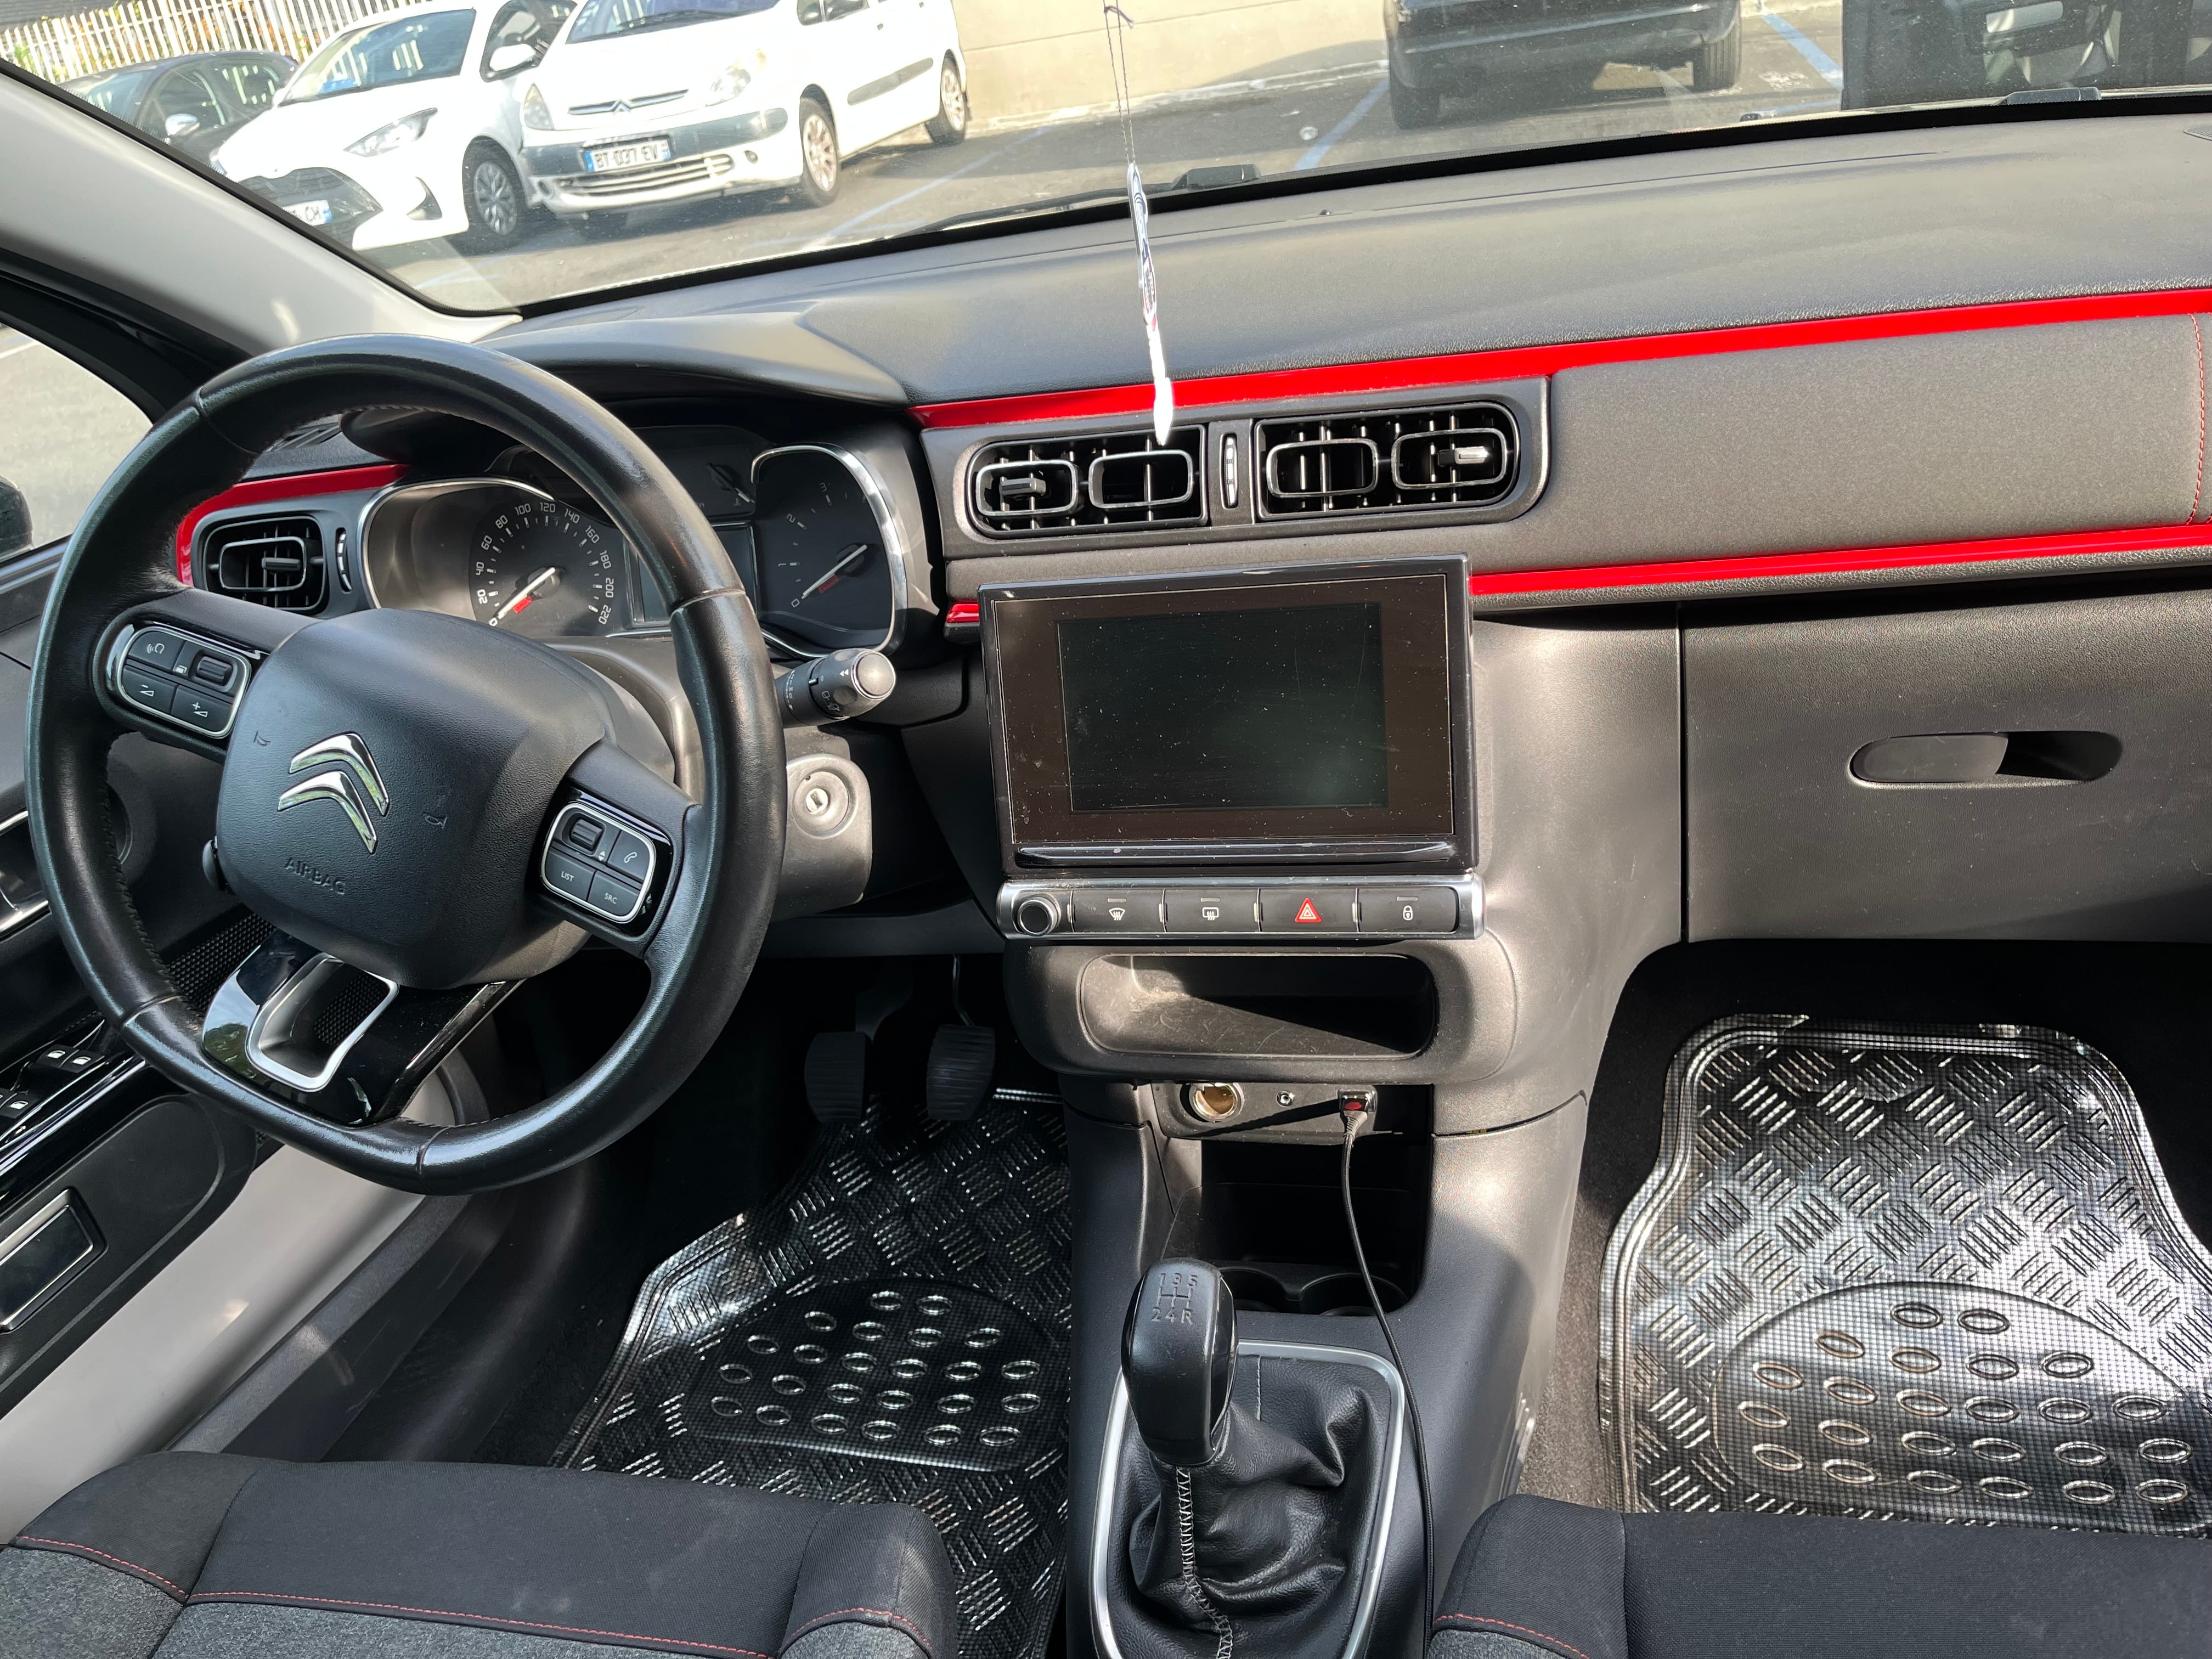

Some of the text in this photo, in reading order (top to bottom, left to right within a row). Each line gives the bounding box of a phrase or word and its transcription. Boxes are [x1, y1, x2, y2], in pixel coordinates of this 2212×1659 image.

[820, 482, 827, 492] 3
[515, 503, 531, 516] 100
[540, 502, 556, 513] 120
[495, 515, 508, 529] 80
[564, 508, 580, 524] 140
[786, 514, 795, 523] 2
[585, 525, 600, 544] 160
[481, 535, 493, 550] 60
[599, 550, 612, 569] 180
[476, 561, 484, 575] 40
[605, 577, 614, 598] 200
[477, 589, 488, 605] 20
[791, 599, 800, 608] 0
[488, 617, 498, 627] 0
[598, 605, 612, 625] 220
[284, 857, 346, 895] AIRBAG
[561, 871, 574, 882] LIST
[605, 893, 618, 904] SRC
[1159, 1273, 1198, 1287] 1 3 5
[1152, 1307, 1193, 1325] 2 4 R
